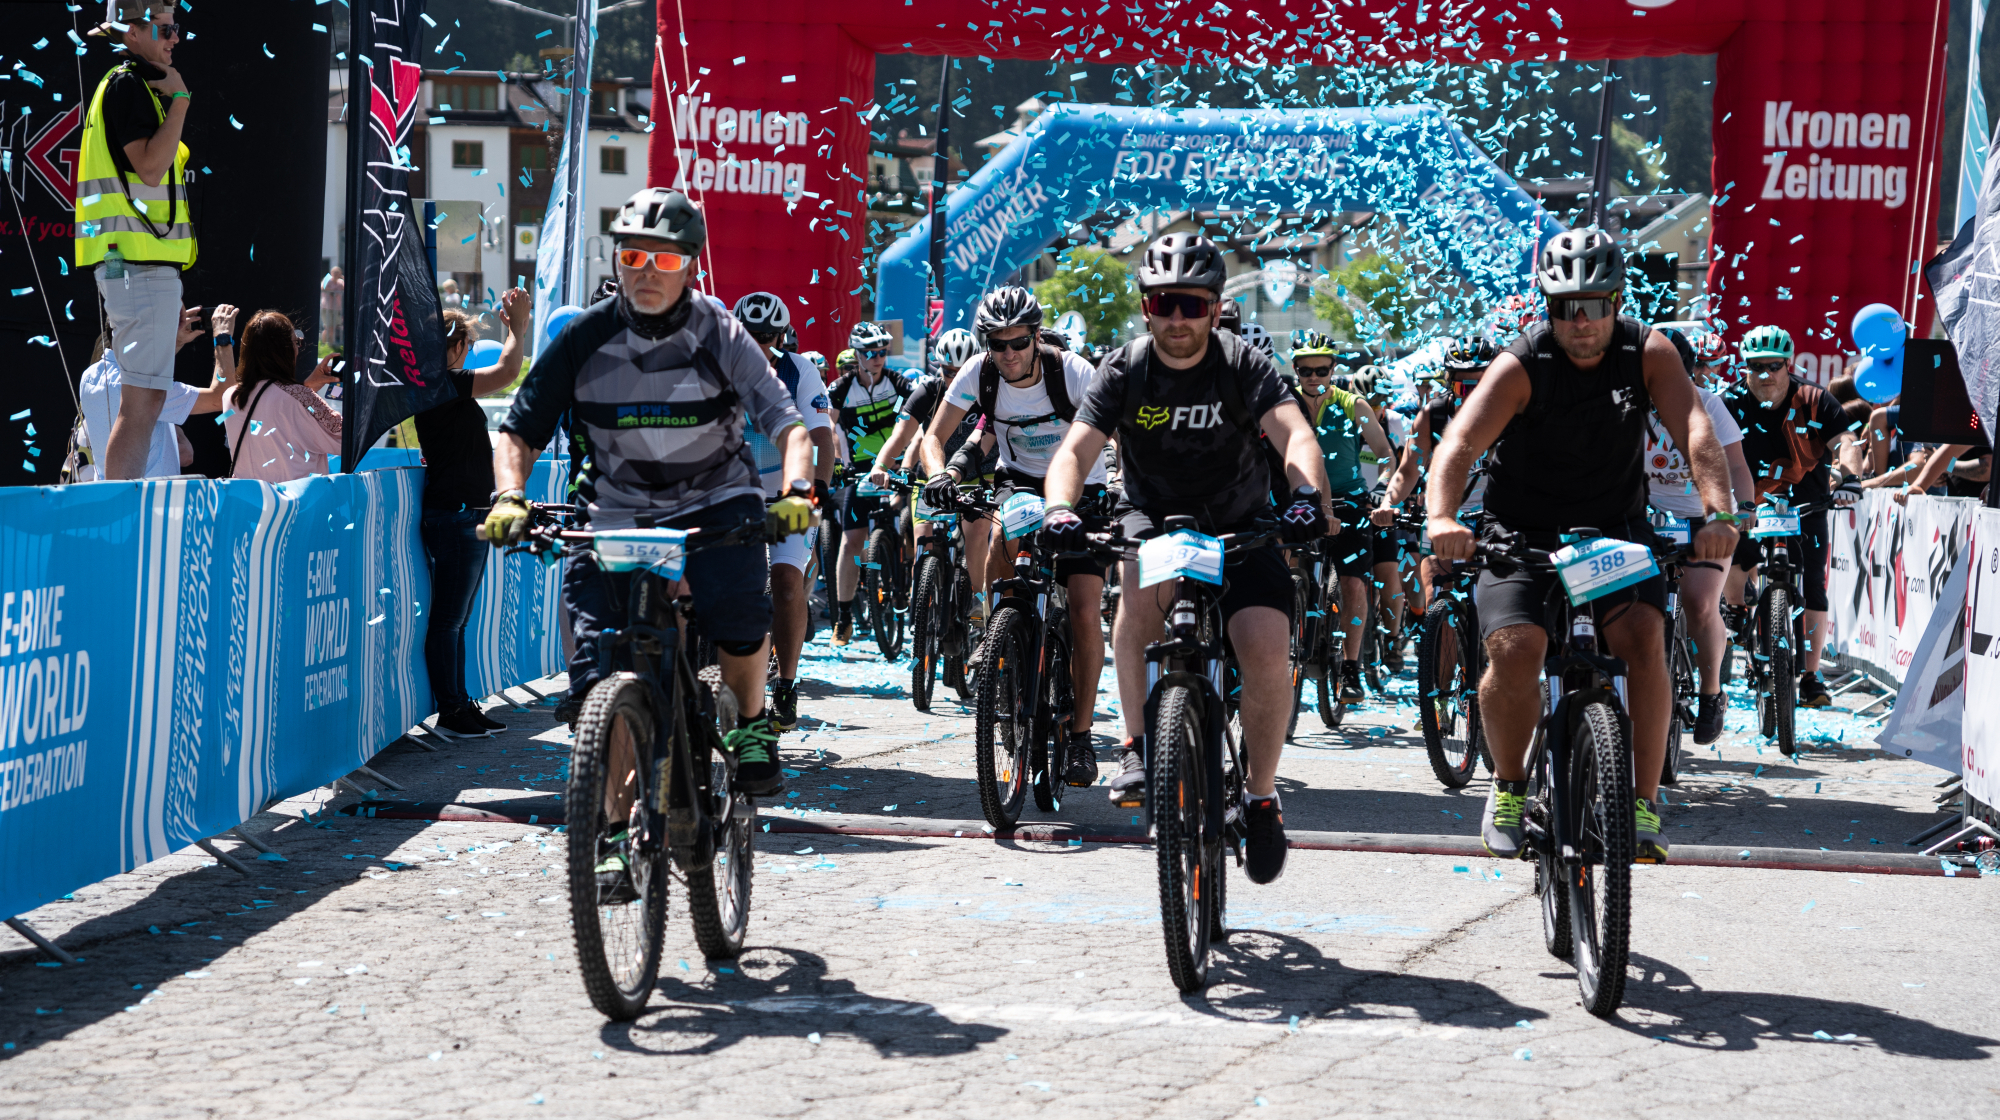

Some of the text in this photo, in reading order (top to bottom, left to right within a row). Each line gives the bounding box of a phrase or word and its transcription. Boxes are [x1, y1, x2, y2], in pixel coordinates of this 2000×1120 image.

[676, 96, 808, 146] Kronen
[1763, 100, 1911, 149] Kronen
[671, 147, 807, 202] Zeitung
[1111, 150, 1177, 181] FOR
[1760, 152, 1908, 209] Zeitung
[19, 216, 38, 235] If
[948, 181, 1049, 272] WINNER
[640, 404, 671, 416] PWS
[640, 416, 698, 425] OFFROAD
[1171, 401, 1224, 430] FOX
[1029, 435, 1061, 447] WINNER
[1020, 502, 1045, 520] 325
[1764, 519, 1787, 527] 327
[624, 544, 661, 557] 354
[1164, 547, 1201, 564] 387
[1589, 550, 1626, 578] 388
[307, 549, 339, 599] E-BIKE
[0, 585, 65, 657] E-BIKE
[233, 531, 249, 695] WINNER
[304, 597, 350, 668] WORLD
[0, 650, 91, 750] WORLD
[304, 663, 349, 713] FEDERATION
